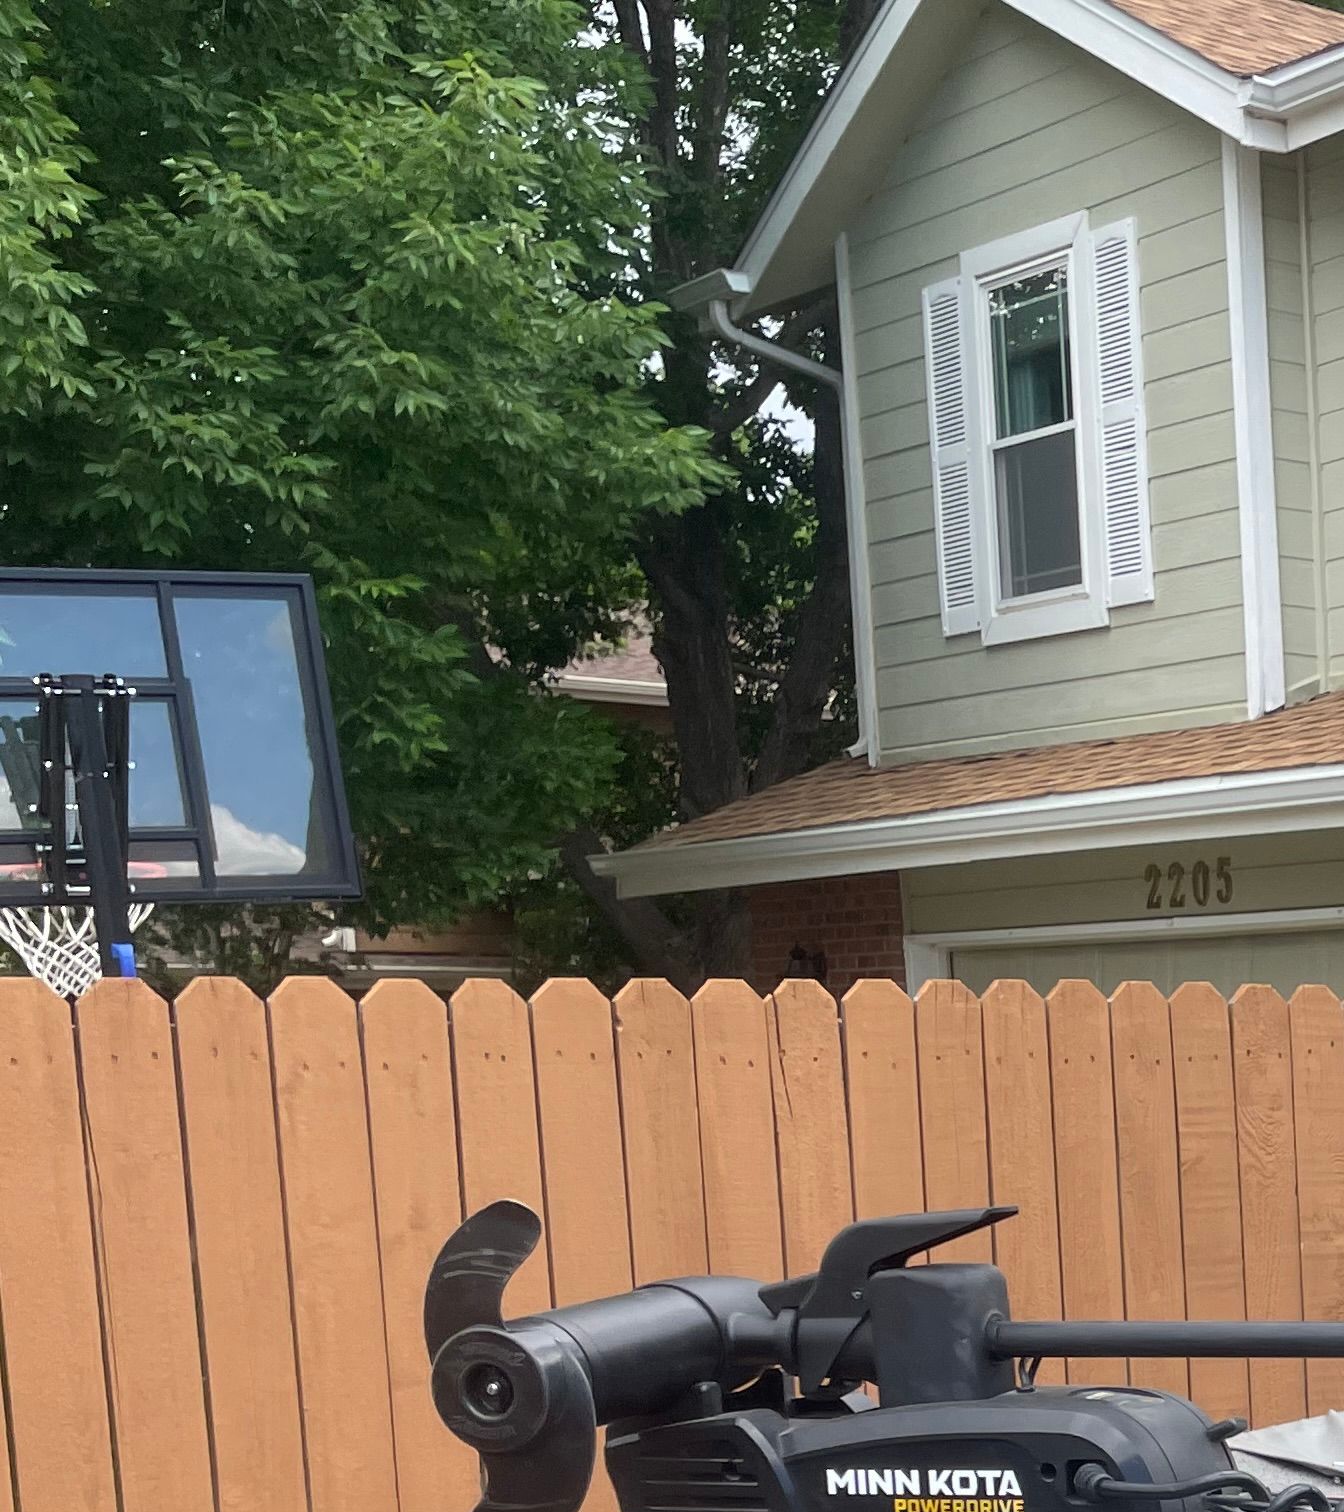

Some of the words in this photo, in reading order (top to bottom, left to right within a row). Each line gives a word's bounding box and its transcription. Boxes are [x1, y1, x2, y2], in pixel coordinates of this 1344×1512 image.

[1144, 856, 1233, 909] 2205
[826, 1468, 921, 1496] MINN
[927, 1469, 1023, 1496] KOTA
